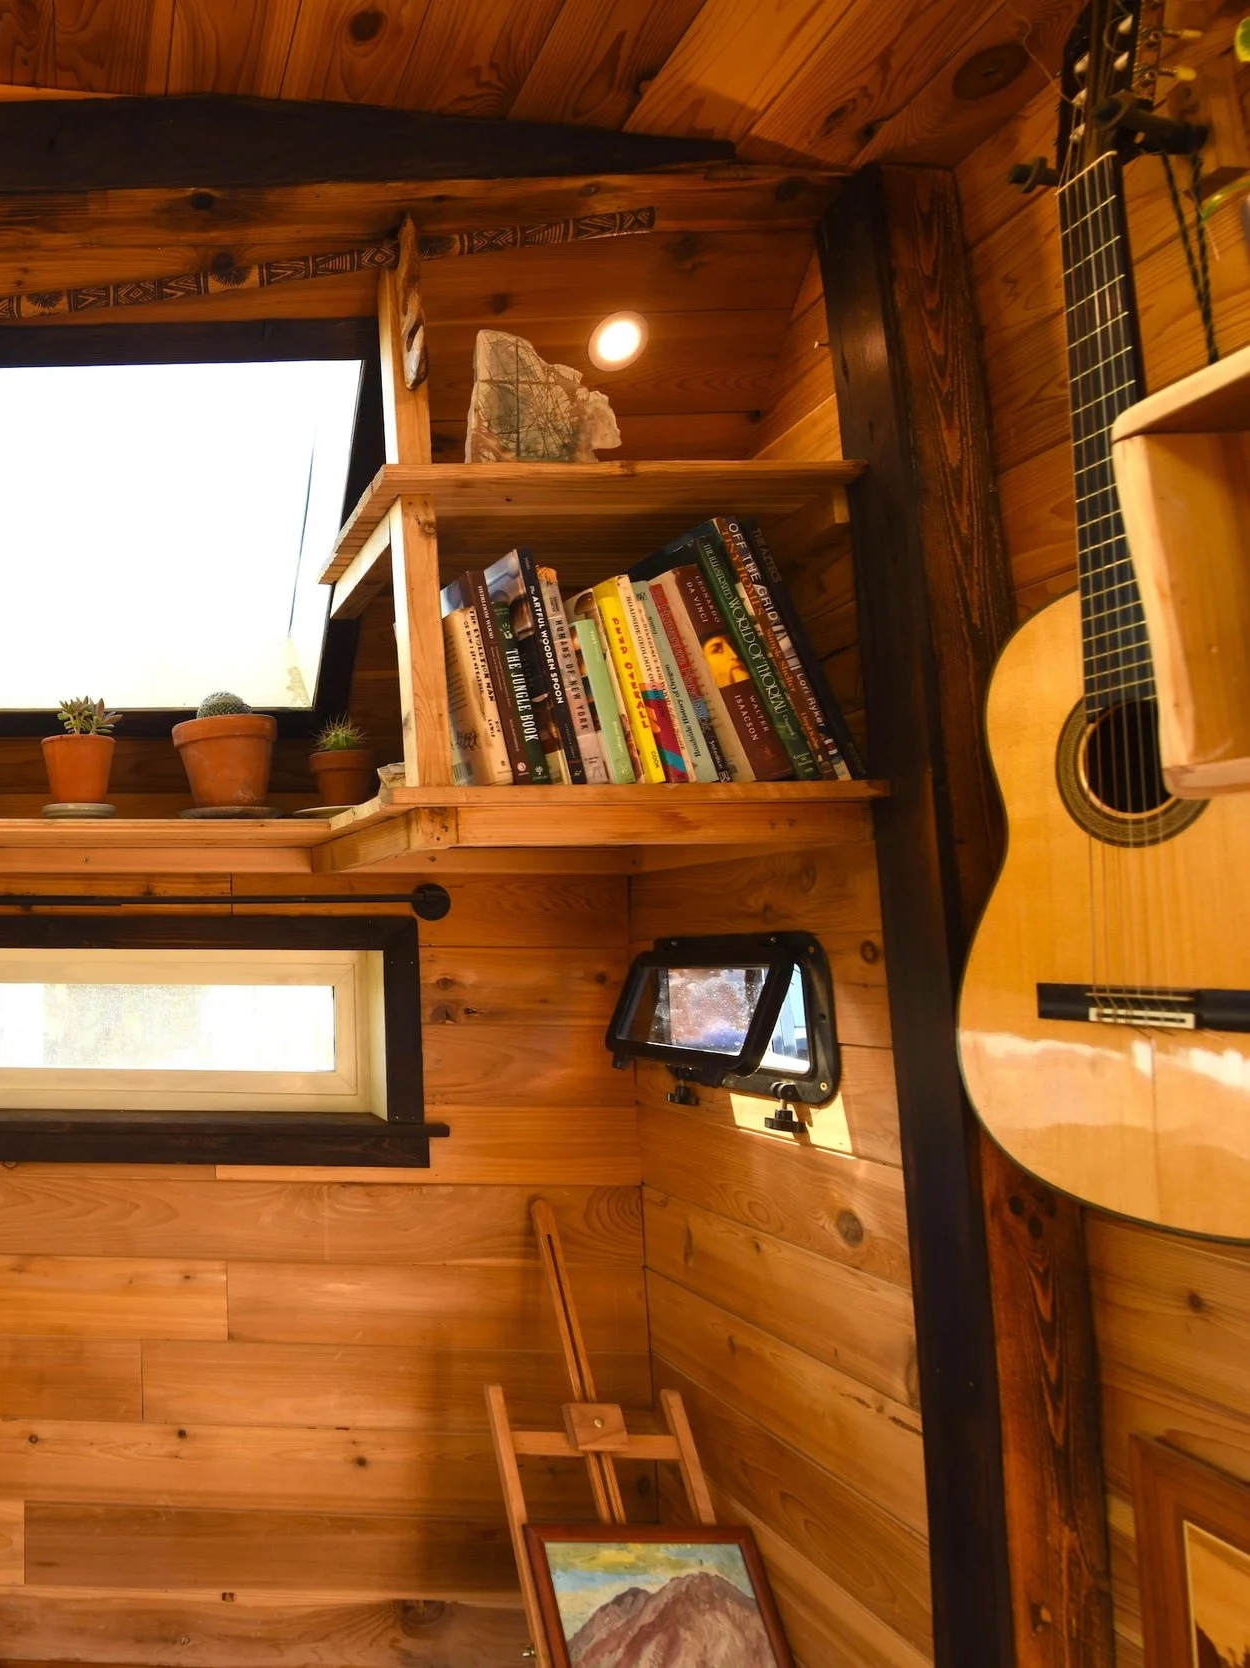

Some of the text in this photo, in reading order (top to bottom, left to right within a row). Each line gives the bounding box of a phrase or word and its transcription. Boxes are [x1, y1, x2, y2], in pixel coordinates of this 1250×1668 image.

[722, 528, 765, 616] TINY HOMES
[728, 522, 779, 621] OFF THE GRID
[760, 544, 784, 583] AZTECS
[477, 584, 495, 640] HEIRLOOM WOOD
[686, 581, 709, 623] DA VINCI
[695, 575, 720, 623] LEONARDO
[729, 596, 755, 644] WORLD
[532, 595, 545, 630] ARTFUL
[540, 630, 556, 670] WOODEN
[550, 672, 564, 704] SPOON
[625, 596, 640, 636] ROADSIDE
[636, 635, 652, 671] GEOLOGY
[748, 642, 765, 660] OF
[473, 628, 490, 679] EVOLUTION
[486, 681, 496, 702] MAN
[506, 648, 523, 670] THE
[555, 619, 589, 730] HUMANS OF NEW YORK
[612, 617, 649, 729] BEND OVERALL
[664, 664, 678, 694] Oregon
[766, 628, 797, 693] Simple Shelter
[511, 673, 532, 712] JUNGLE
[756, 660, 787, 715] THOREAU
[796, 673, 826, 728] Lori Ryker
[520, 714, 539, 742] BOOK
[677, 699, 690, 726] History
[734, 694, 759, 741] ISAACSON
[750, 695, 769, 732] WALTER
[650, 750, 660, 769] COOK
[686, 726, 702, 758] Roadside
